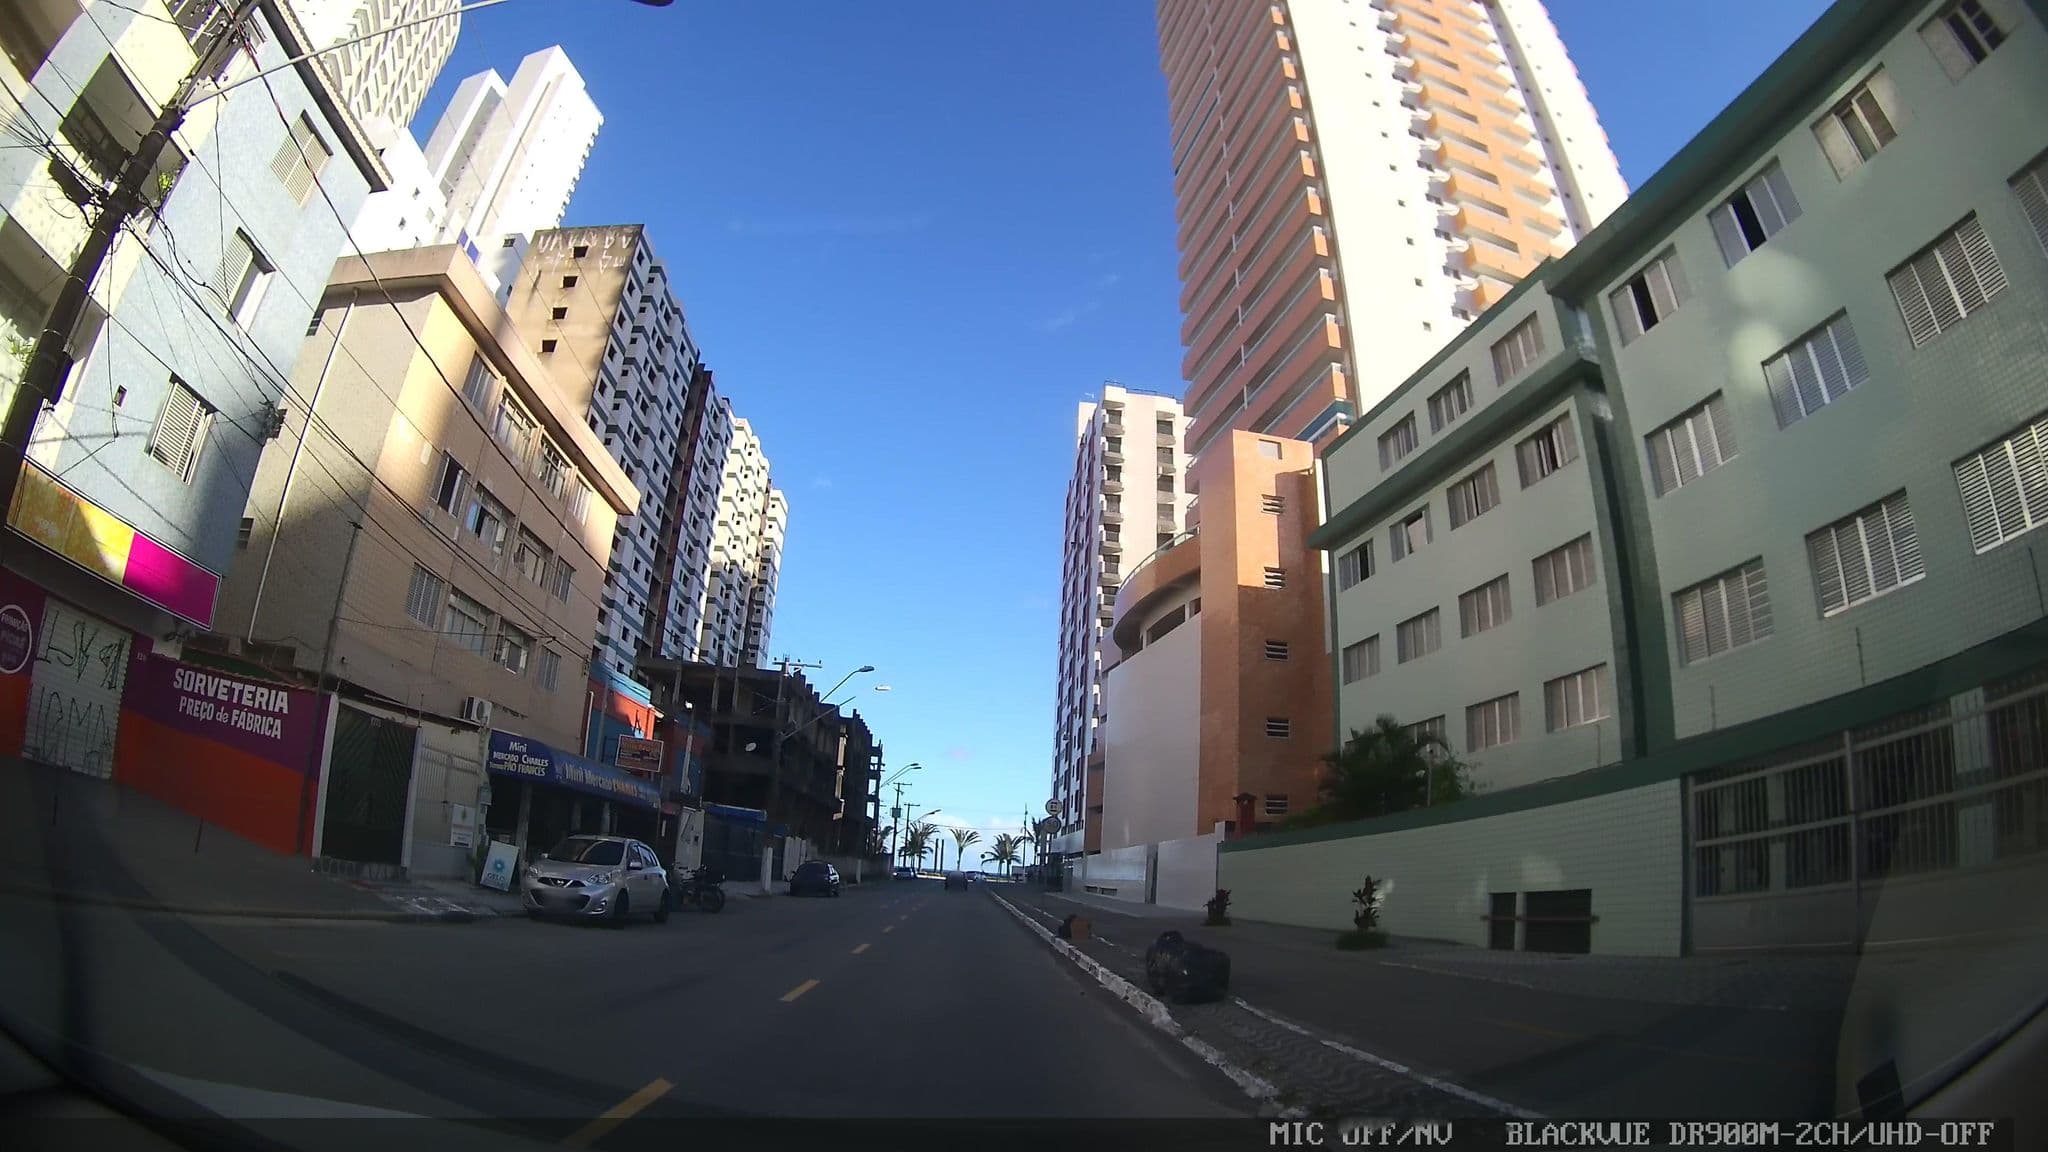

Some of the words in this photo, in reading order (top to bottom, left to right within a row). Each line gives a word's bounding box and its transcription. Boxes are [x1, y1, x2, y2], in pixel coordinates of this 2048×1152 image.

[173, 668, 289, 714] SORVETERIA
[179, 695, 215, 722] PREÇO
[215, 706, 229, 723] de
[230, 708, 282, 740] FÁBRICA
[509, 741, 527, 753] Mini
[521, 754, 549, 767] CHARLES
